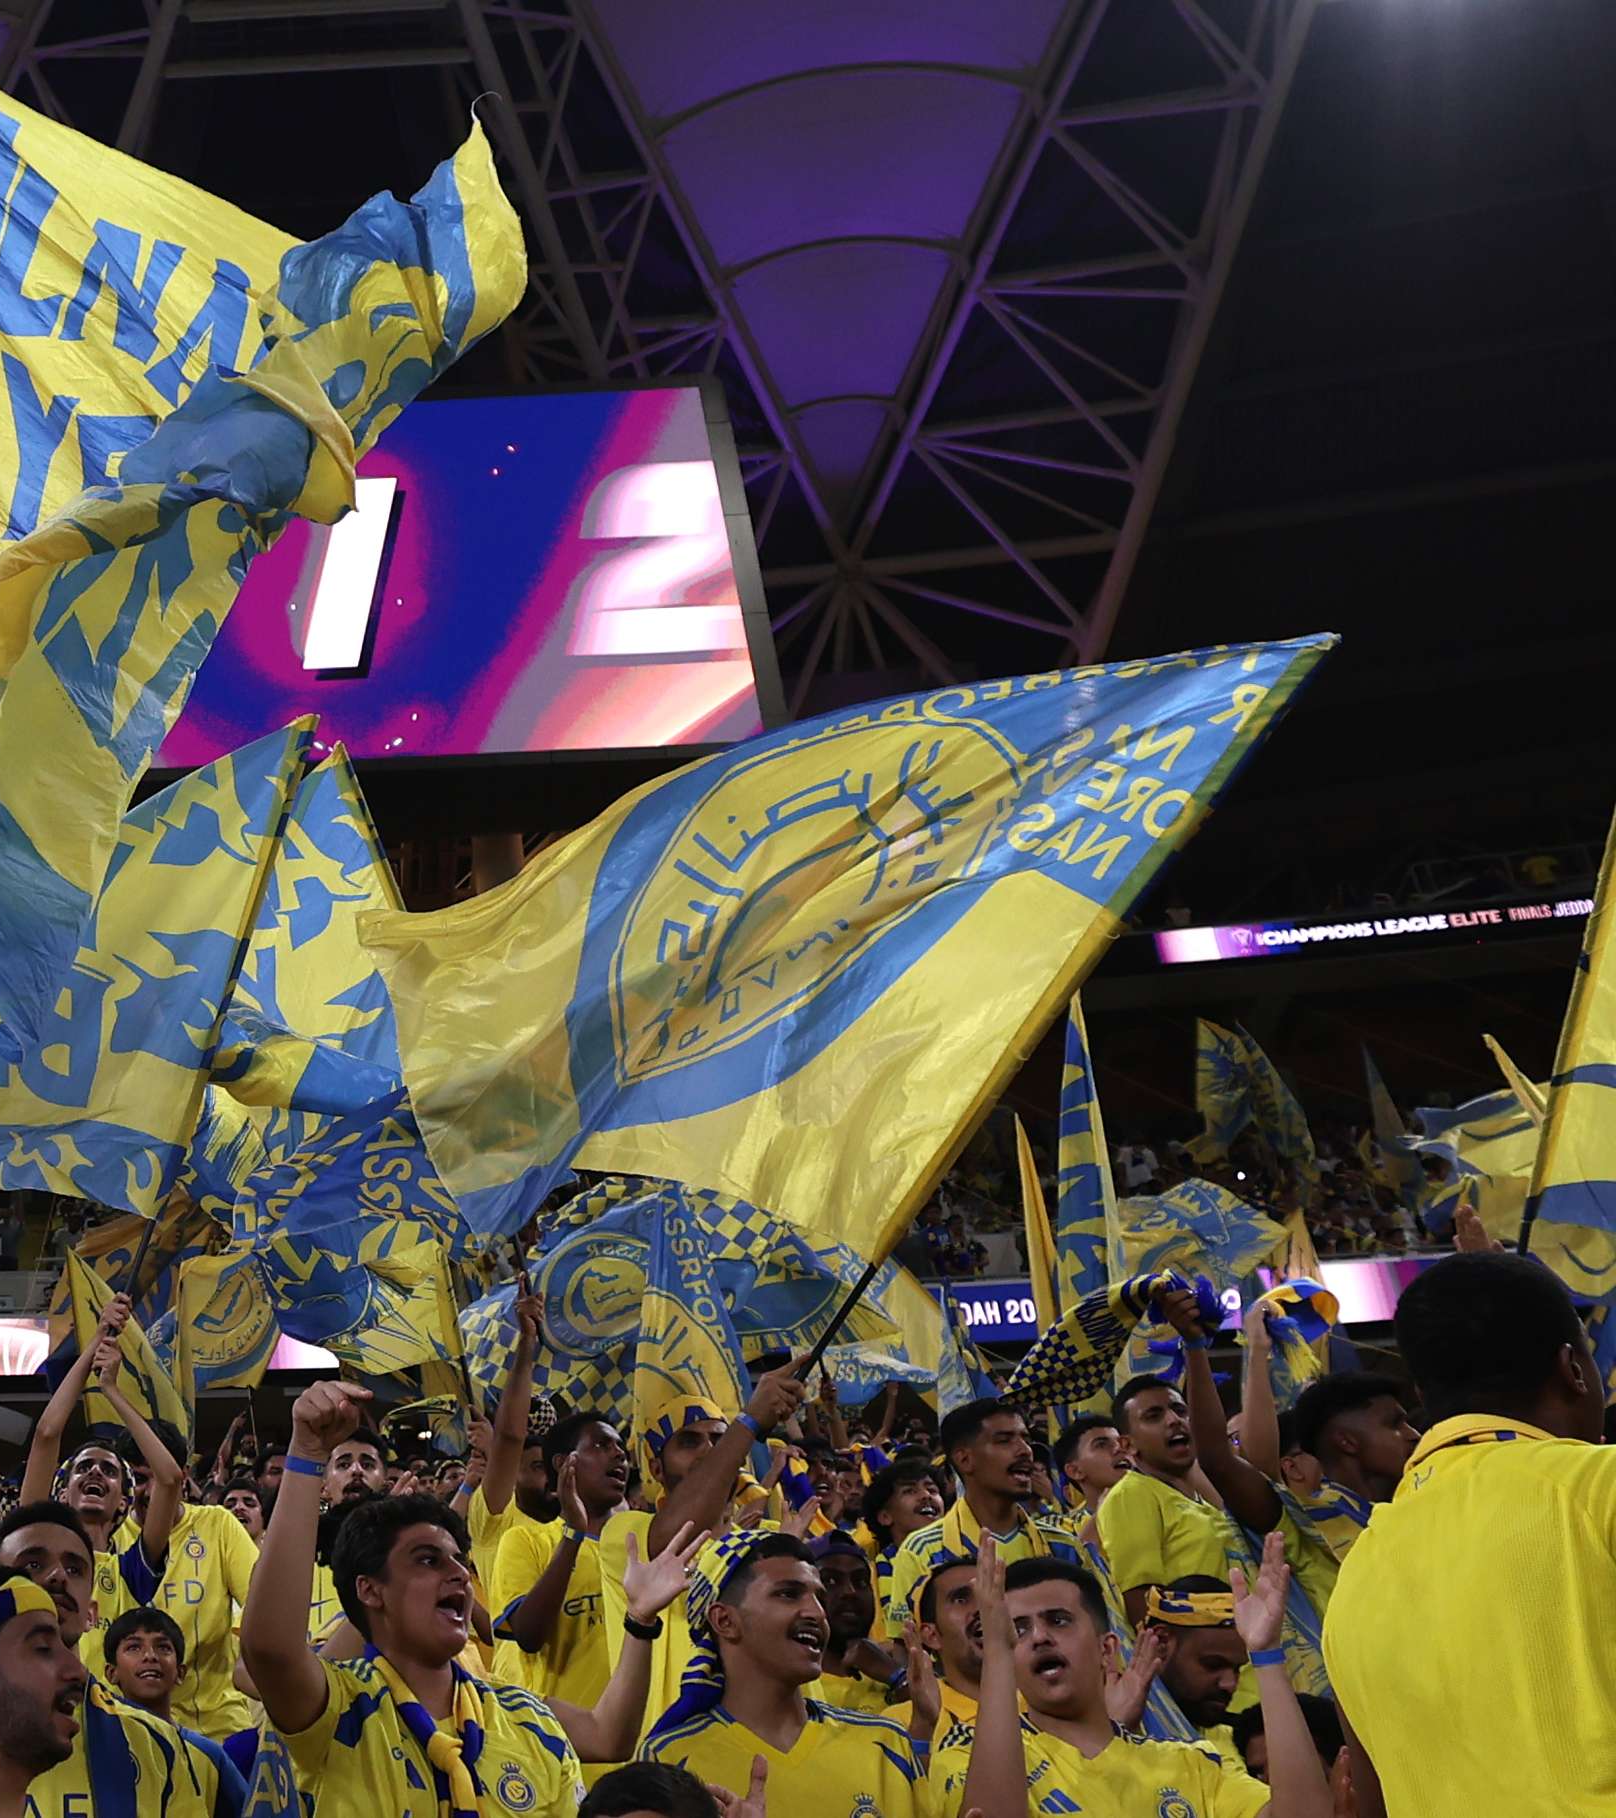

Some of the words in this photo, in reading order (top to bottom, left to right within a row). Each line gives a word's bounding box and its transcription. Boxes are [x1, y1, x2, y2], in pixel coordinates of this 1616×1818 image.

[565, 460, 748, 657] 2
[1263, 921, 1374, 946] CHAMPIONS
[1373, 914, 1449, 936] LEAGUE
[1448, 909, 1503, 928] ELITE
[1508, 904, 1553, 921] FINALS
